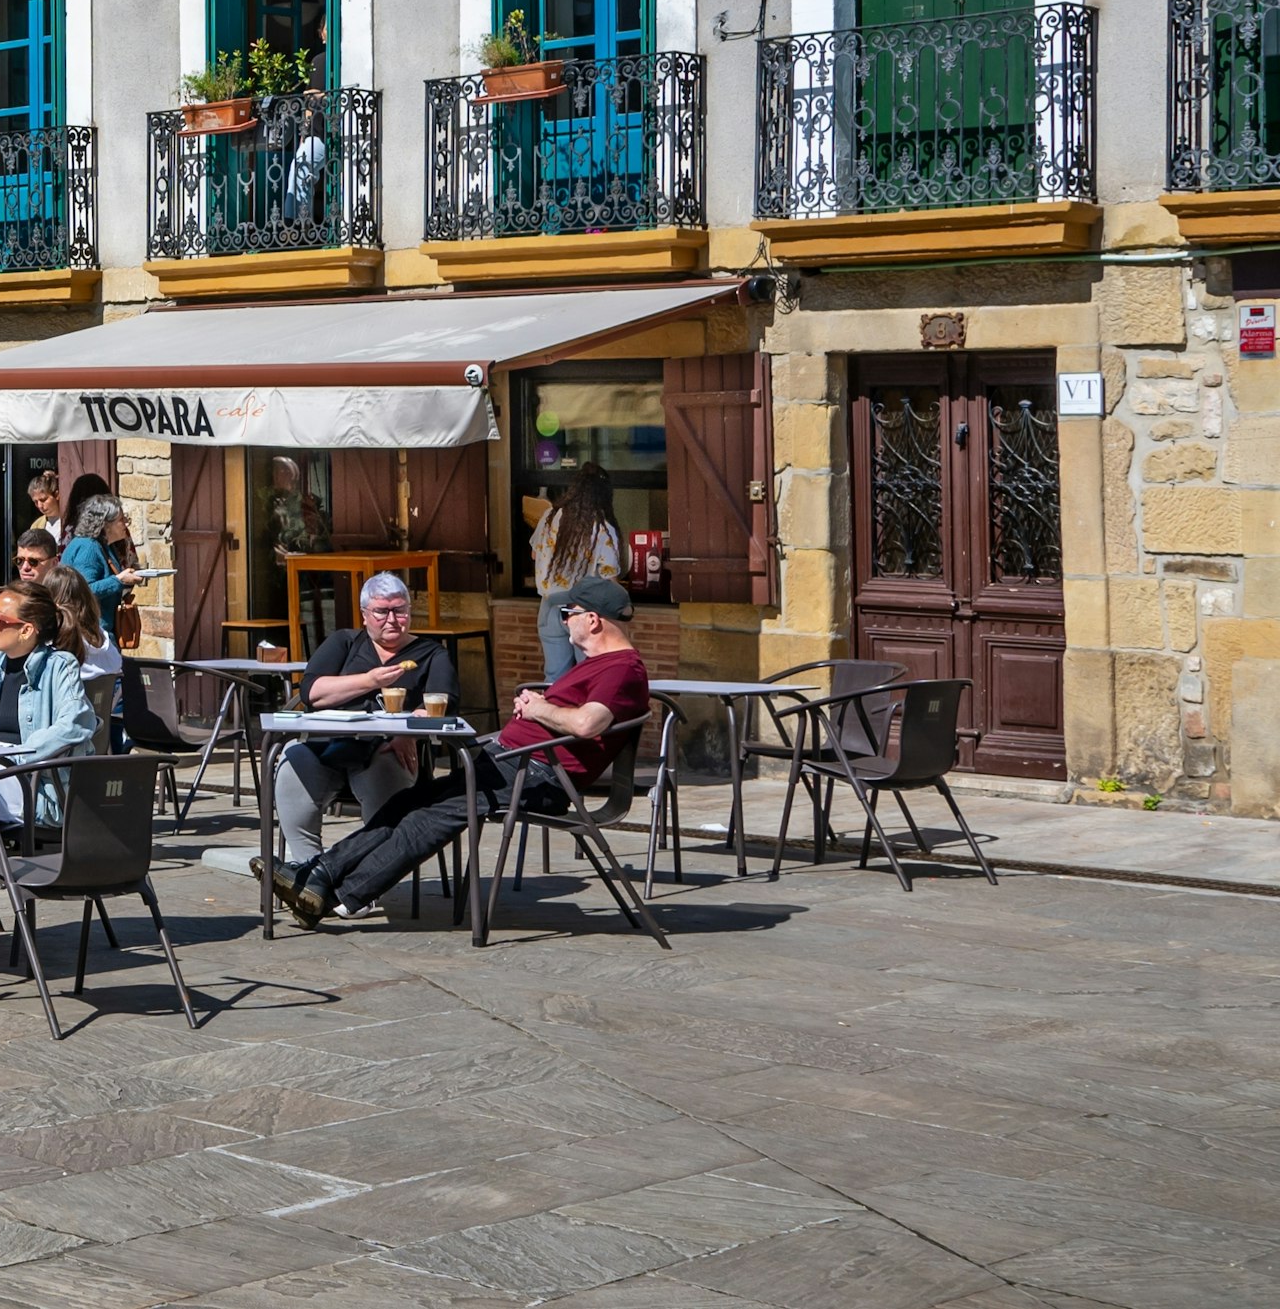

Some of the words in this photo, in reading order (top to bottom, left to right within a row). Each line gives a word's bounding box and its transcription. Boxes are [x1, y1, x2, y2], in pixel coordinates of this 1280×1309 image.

[1064, 379, 1098, 400] VT
[79, 395, 215, 438] TTOPARA
[216, 395, 267, 438] café
